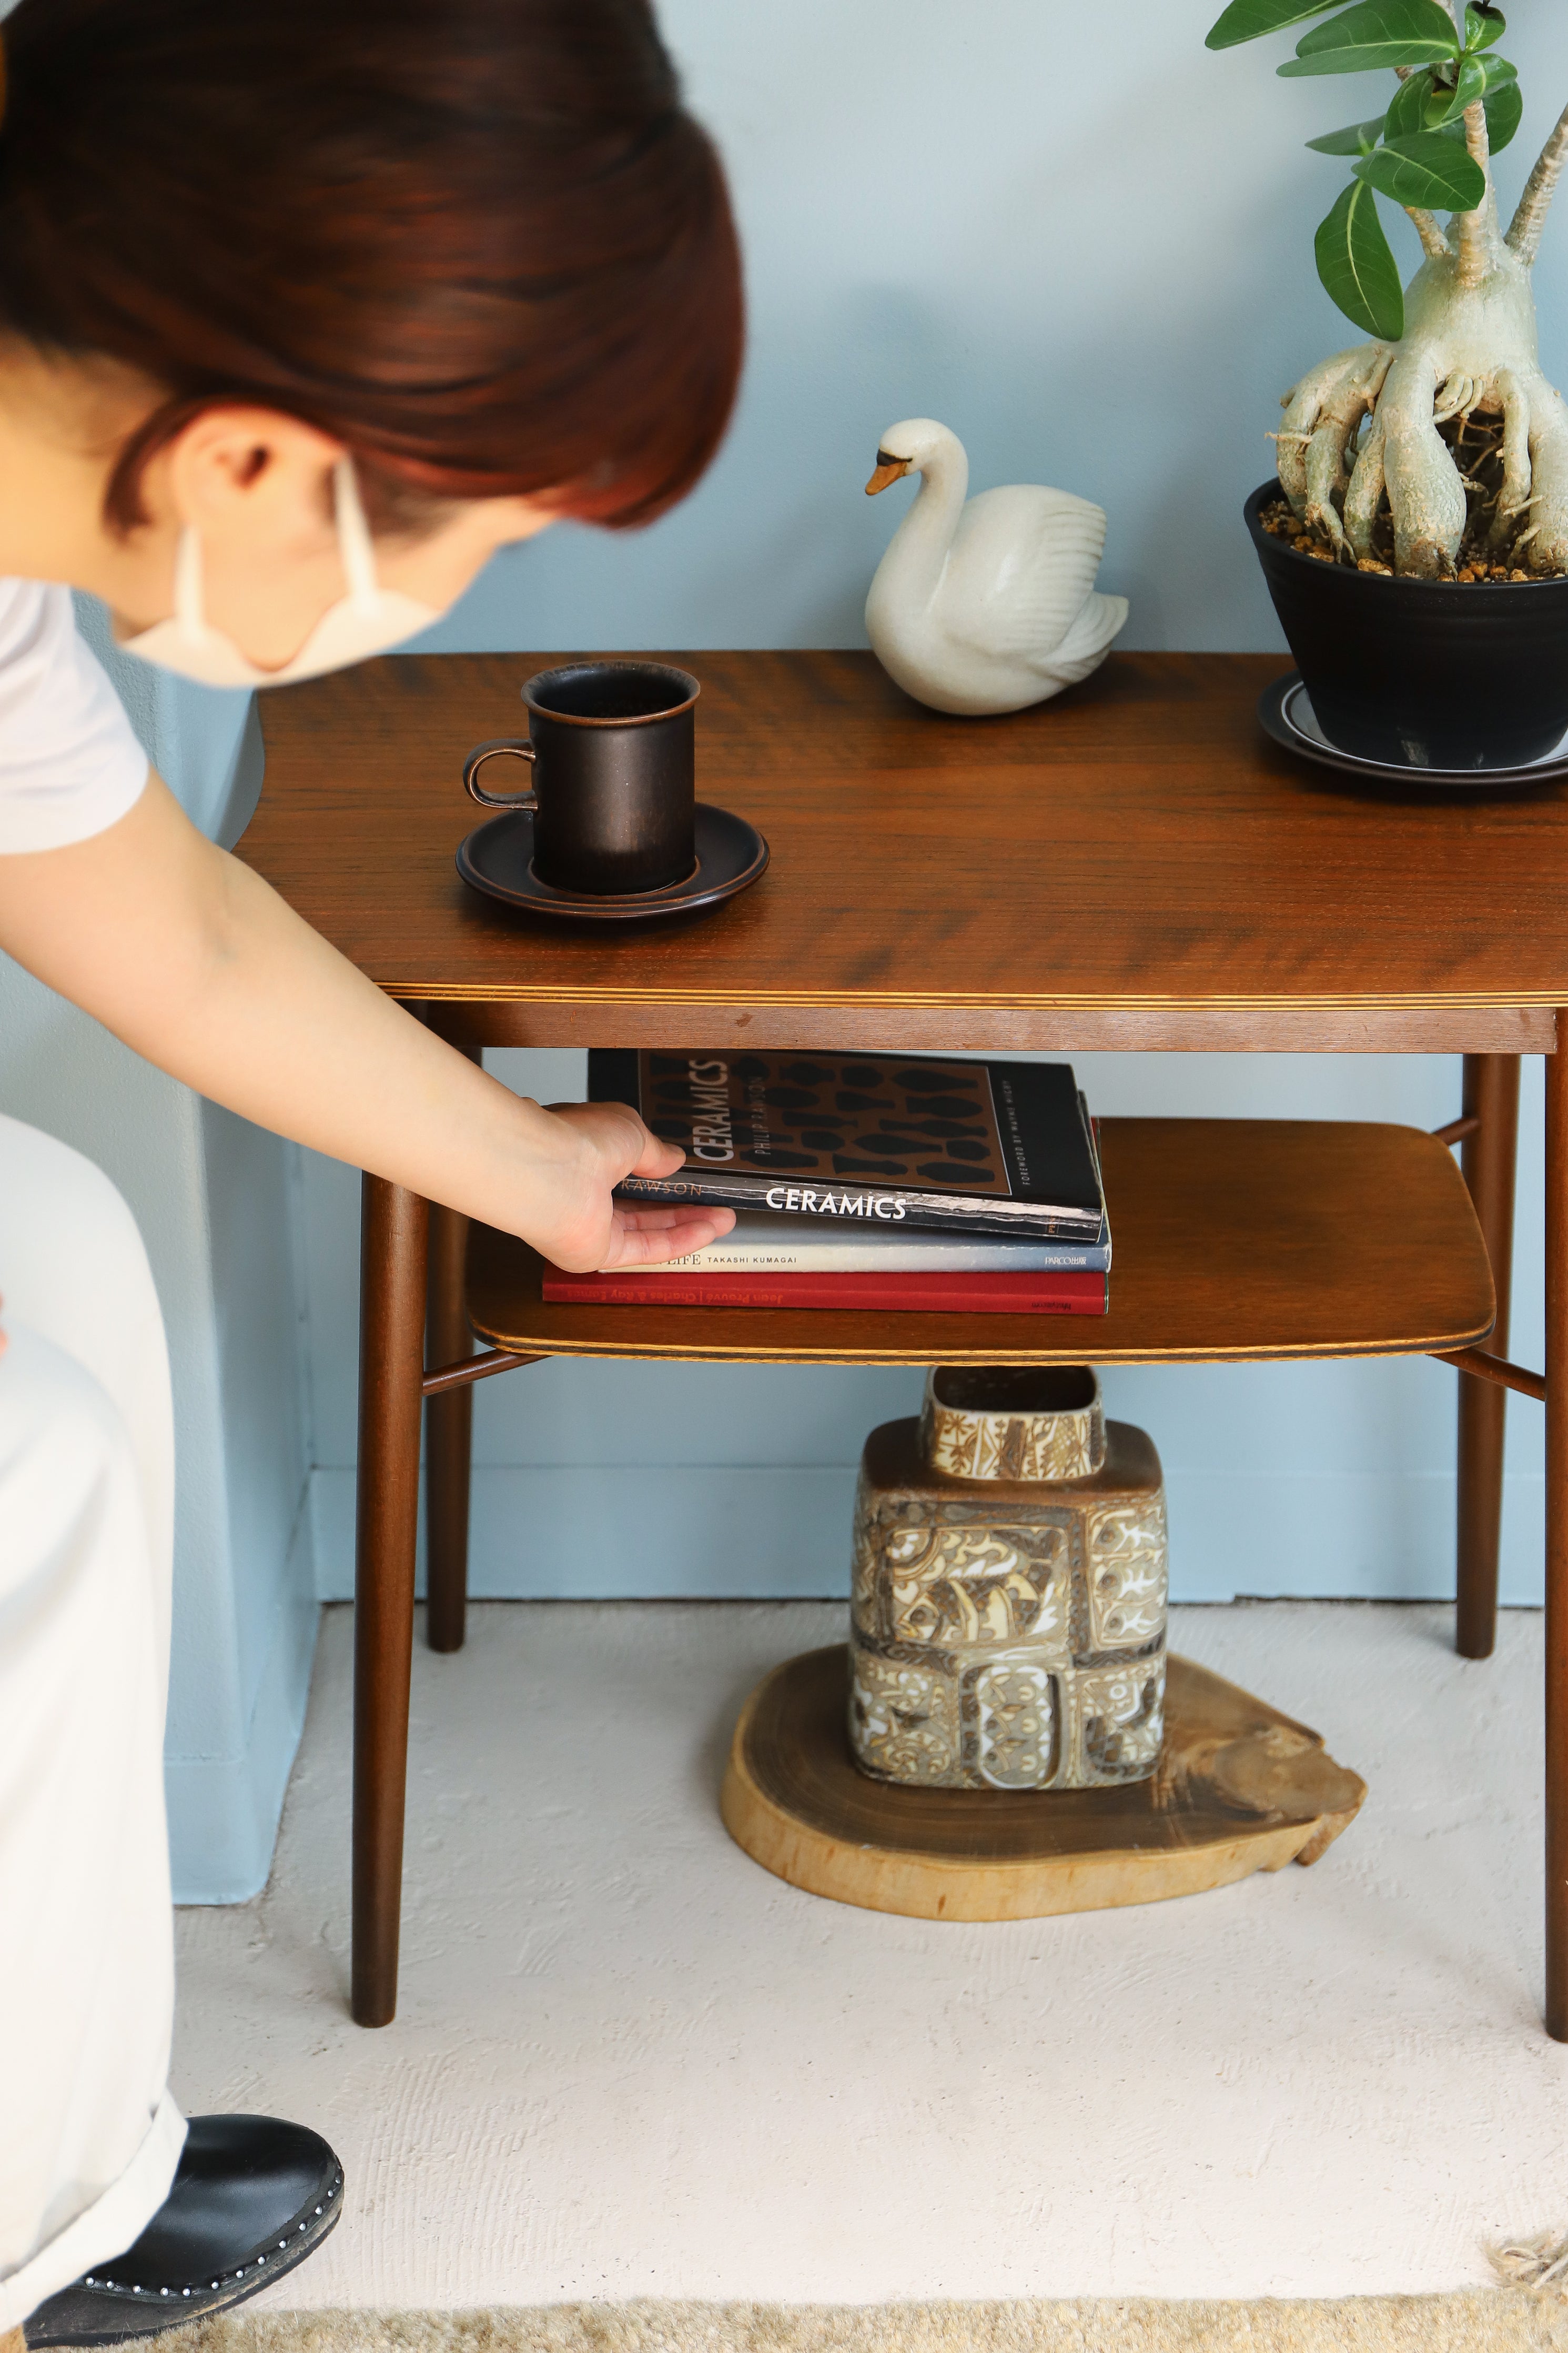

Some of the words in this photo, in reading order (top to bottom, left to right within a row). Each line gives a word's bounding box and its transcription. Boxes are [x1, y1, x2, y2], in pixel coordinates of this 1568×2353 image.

[689, 1059, 735, 1162] CERAMICS
[751, 1123, 771, 1155] PHILIP
[1015, 1147, 1030, 1186] FOREWORD
[621, 1179, 702, 1196] RAWSON
[766, 1187, 906, 1220] CERAMICS
[610, 1289, 634, 1301] Ray
[638, 1292, 647, 1301] &
[650, 1292, 696, 1302] Charles
[706, 1293, 750, 1304] Prouvé
[753, 1294, 783, 1304] Jean
